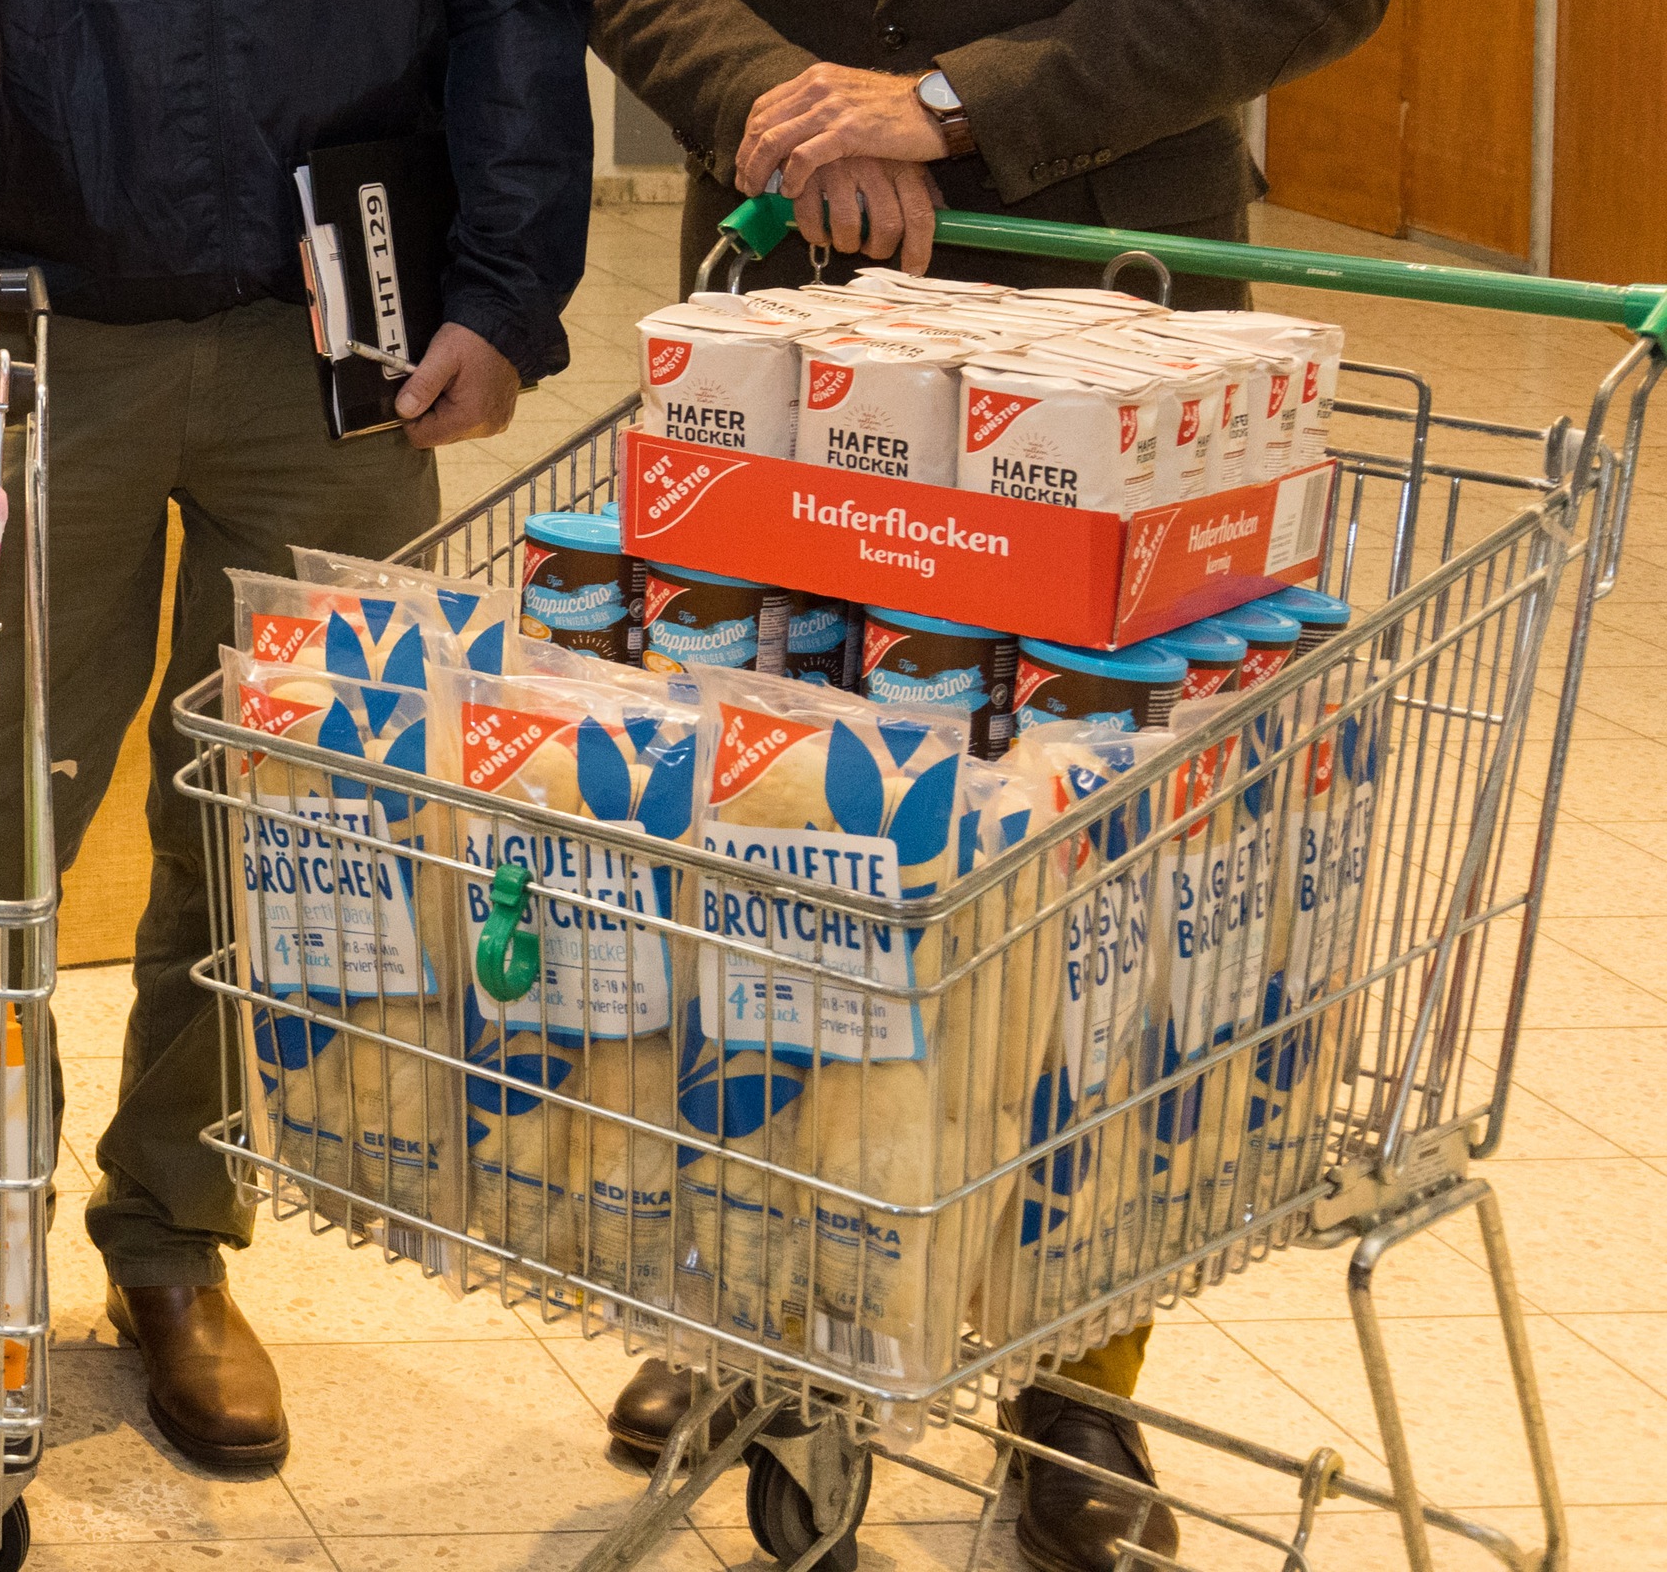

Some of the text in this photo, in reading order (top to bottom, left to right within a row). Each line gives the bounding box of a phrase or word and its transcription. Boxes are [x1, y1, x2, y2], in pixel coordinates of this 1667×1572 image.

[367, 195, 389, 257] 129
[667, 402, 745, 430] HAFER
[970, 396, 993, 416] GUT
[973, 401, 1022, 442] GÜNSTIG
[983, 410, 994, 421] &
[667, 425, 745, 448] FLOCKEN
[829, 427, 909, 461] HAFER
[643, 455, 674, 484] GUT
[828, 450, 908, 477] FLOCKEN
[992, 456, 1077, 491] HAFER
[648, 464, 711, 520] GÜNSTIG
[661, 475, 675, 489] &
[991, 481, 1077, 508] FLOCKEN
[792, 491, 1010, 557] Haferflocken
[1188, 510, 1259, 553] Haferflocken
[859, 539, 936, 577] kernig
[1205, 553, 1232, 576] kernig
[525, 586, 612, 616] Cappuccino
[651, 622, 748, 652] Cappuccino
[870, 671, 975, 704] Cappuccino
[465, 714, 502, 746] GUT
[486, 737, 503, 751] &
[724, 715, 746, 747] GUT
[469, 724, 543, 786] GÜNSTIG
[719, 729, 788, 788] GÜNSTIG
[704, 889, 892, 954] BRÖTCHEN
[275, 934, 290, 965] 4
[728, 982, 748, 1020] 4
